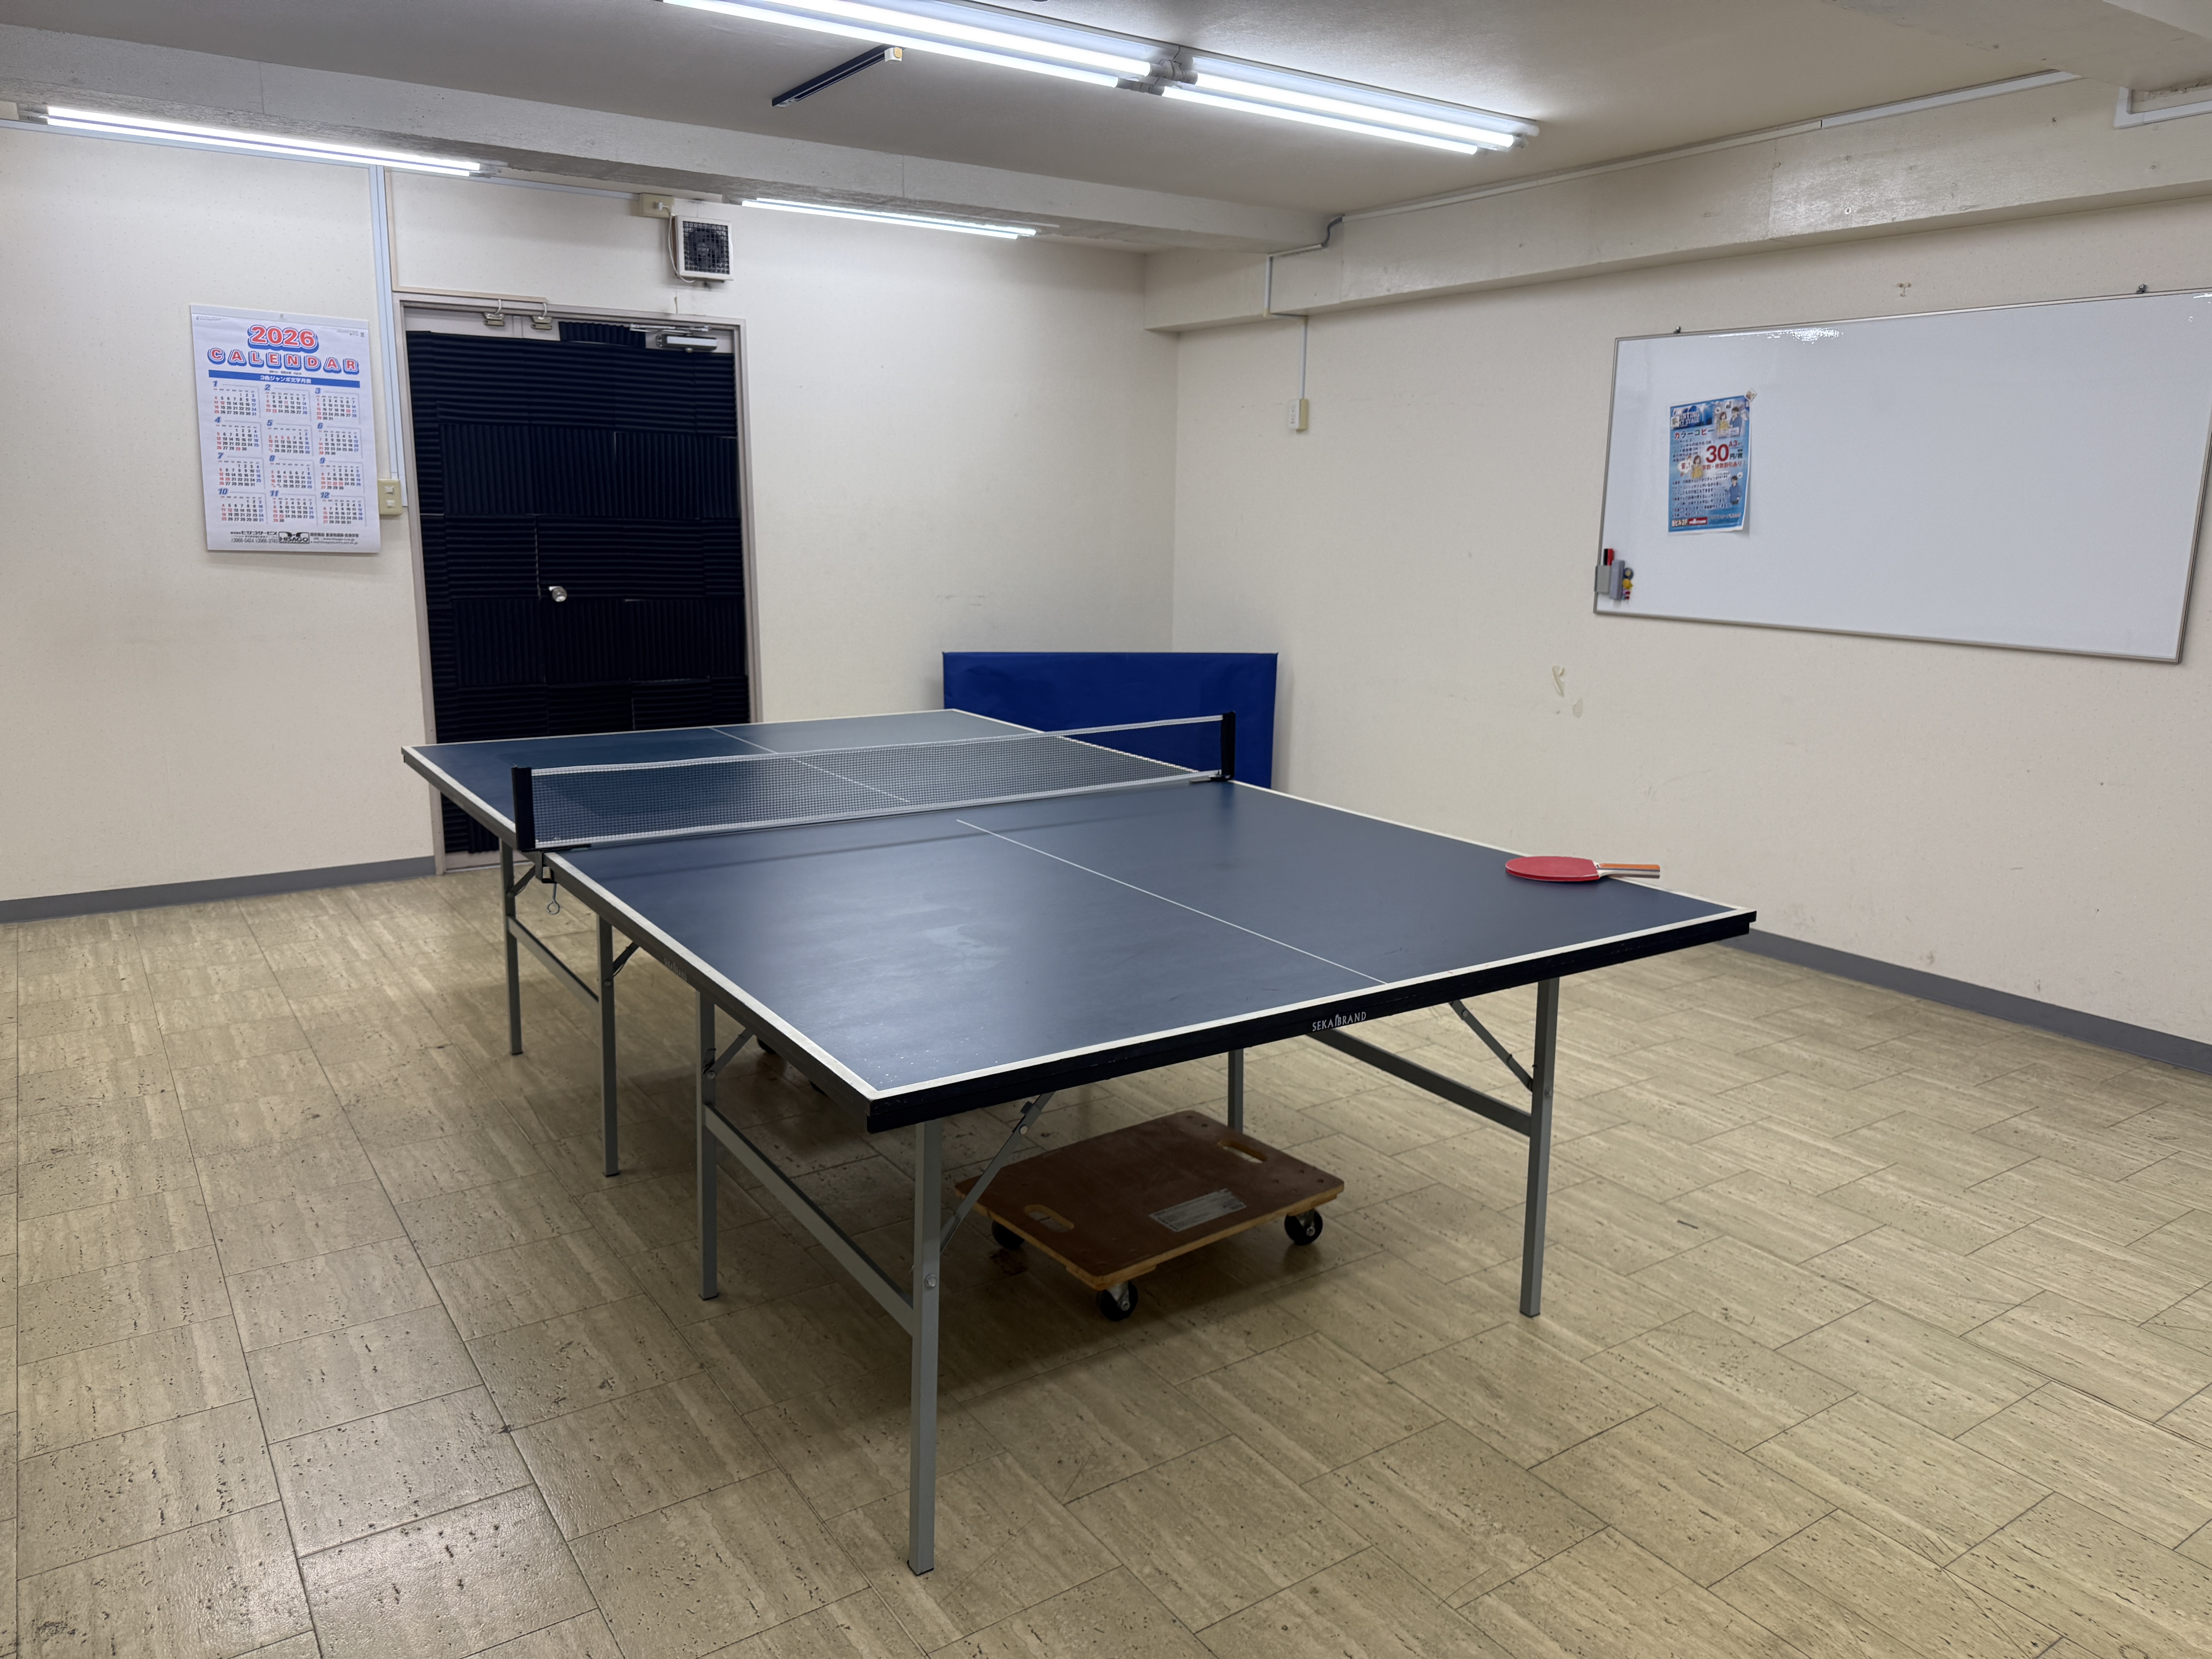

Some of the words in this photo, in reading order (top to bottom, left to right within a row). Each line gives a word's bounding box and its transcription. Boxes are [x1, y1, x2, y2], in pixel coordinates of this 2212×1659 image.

[249, 325, 318, 351] 2026
[208, 348, 359, 373] CALENDAR
[1706, 444, 1729, 463] 30
